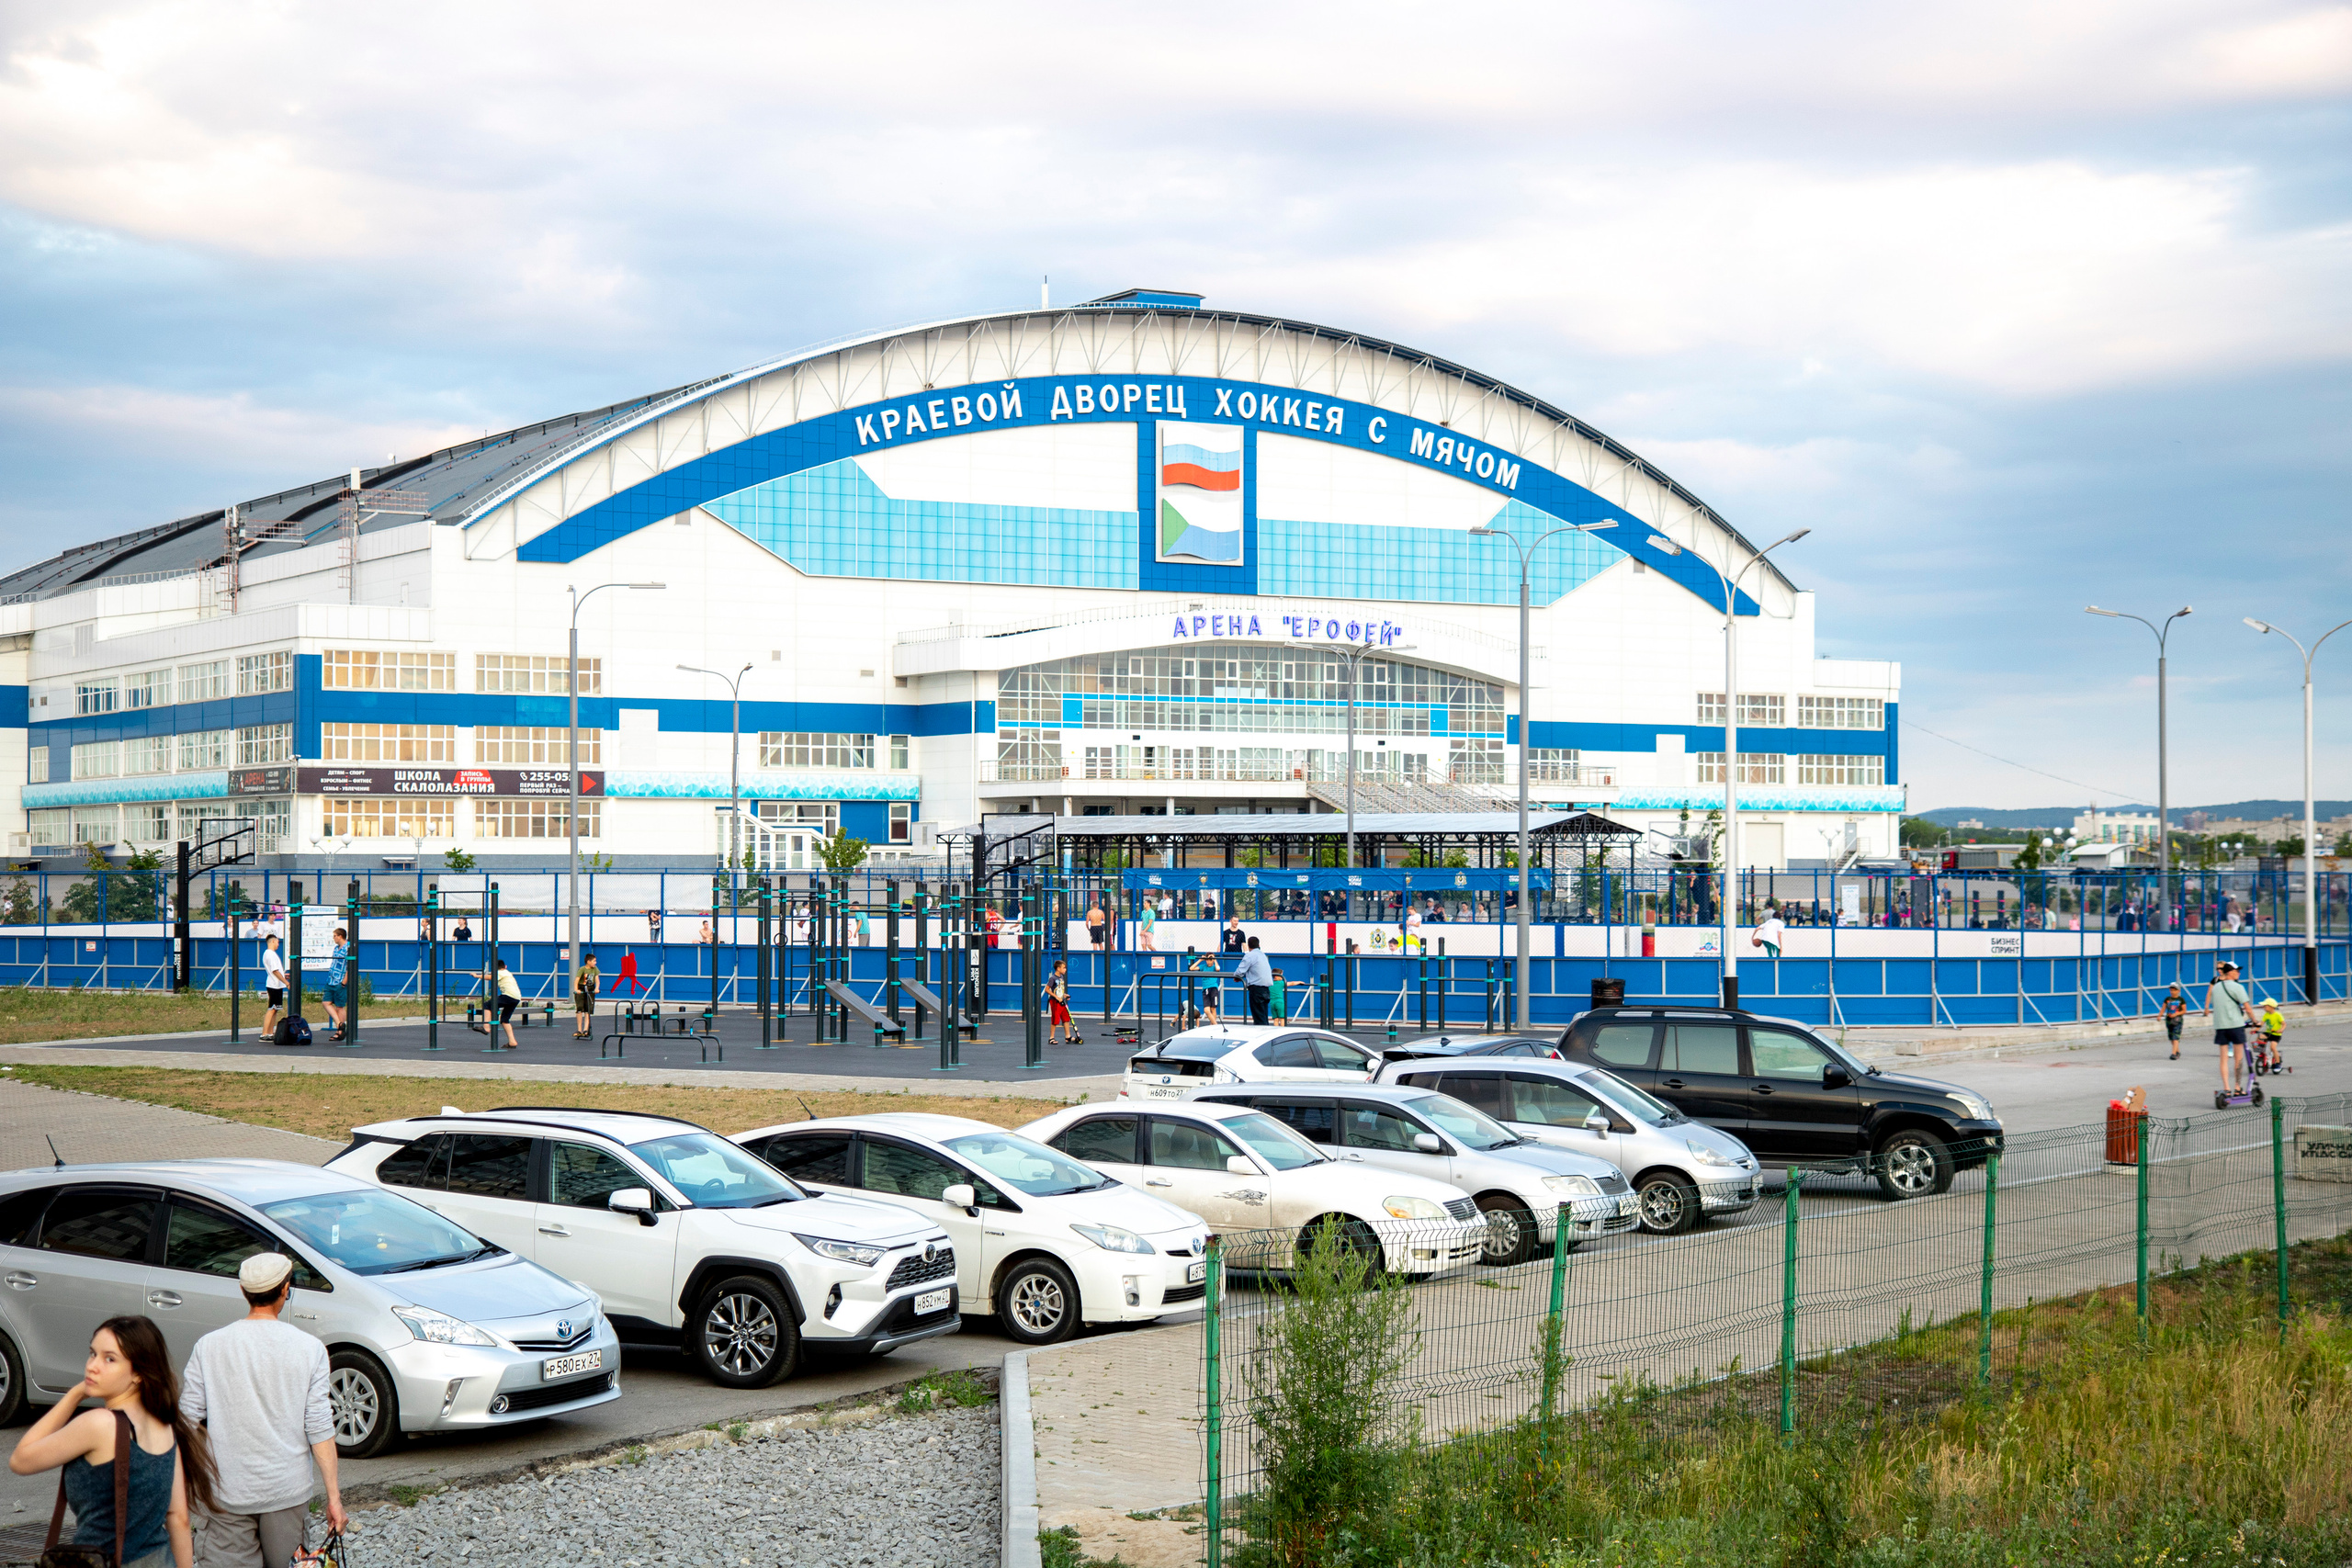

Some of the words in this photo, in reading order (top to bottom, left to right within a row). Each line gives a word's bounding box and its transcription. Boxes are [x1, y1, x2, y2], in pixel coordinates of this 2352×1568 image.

[855, 382, 1023, 446] КРАЕВОЙ
[1050, 384, 1187, 421] ДВОРЕЦ
[1214, 388, 1345, 435] ХОККЕЯ
[1368, 416, 1388, 444] С
[1409, 427, 1521, 491] МЯЧОМ
[1173, 615, 1262, 637] АРЕНА
[1283, 615, 1402, 646] "ЕРОФЕЙ"
[244, 773, 266, 785] АРЕНА
[394, 771, 441, 781] ШКОЛА
[529, 772, 571, 782] 255-05
[393, 782, 495, 794] СКАЛОЛАЗАНИЯ
[1991, 946, 2019, 954] СПРИНТ
